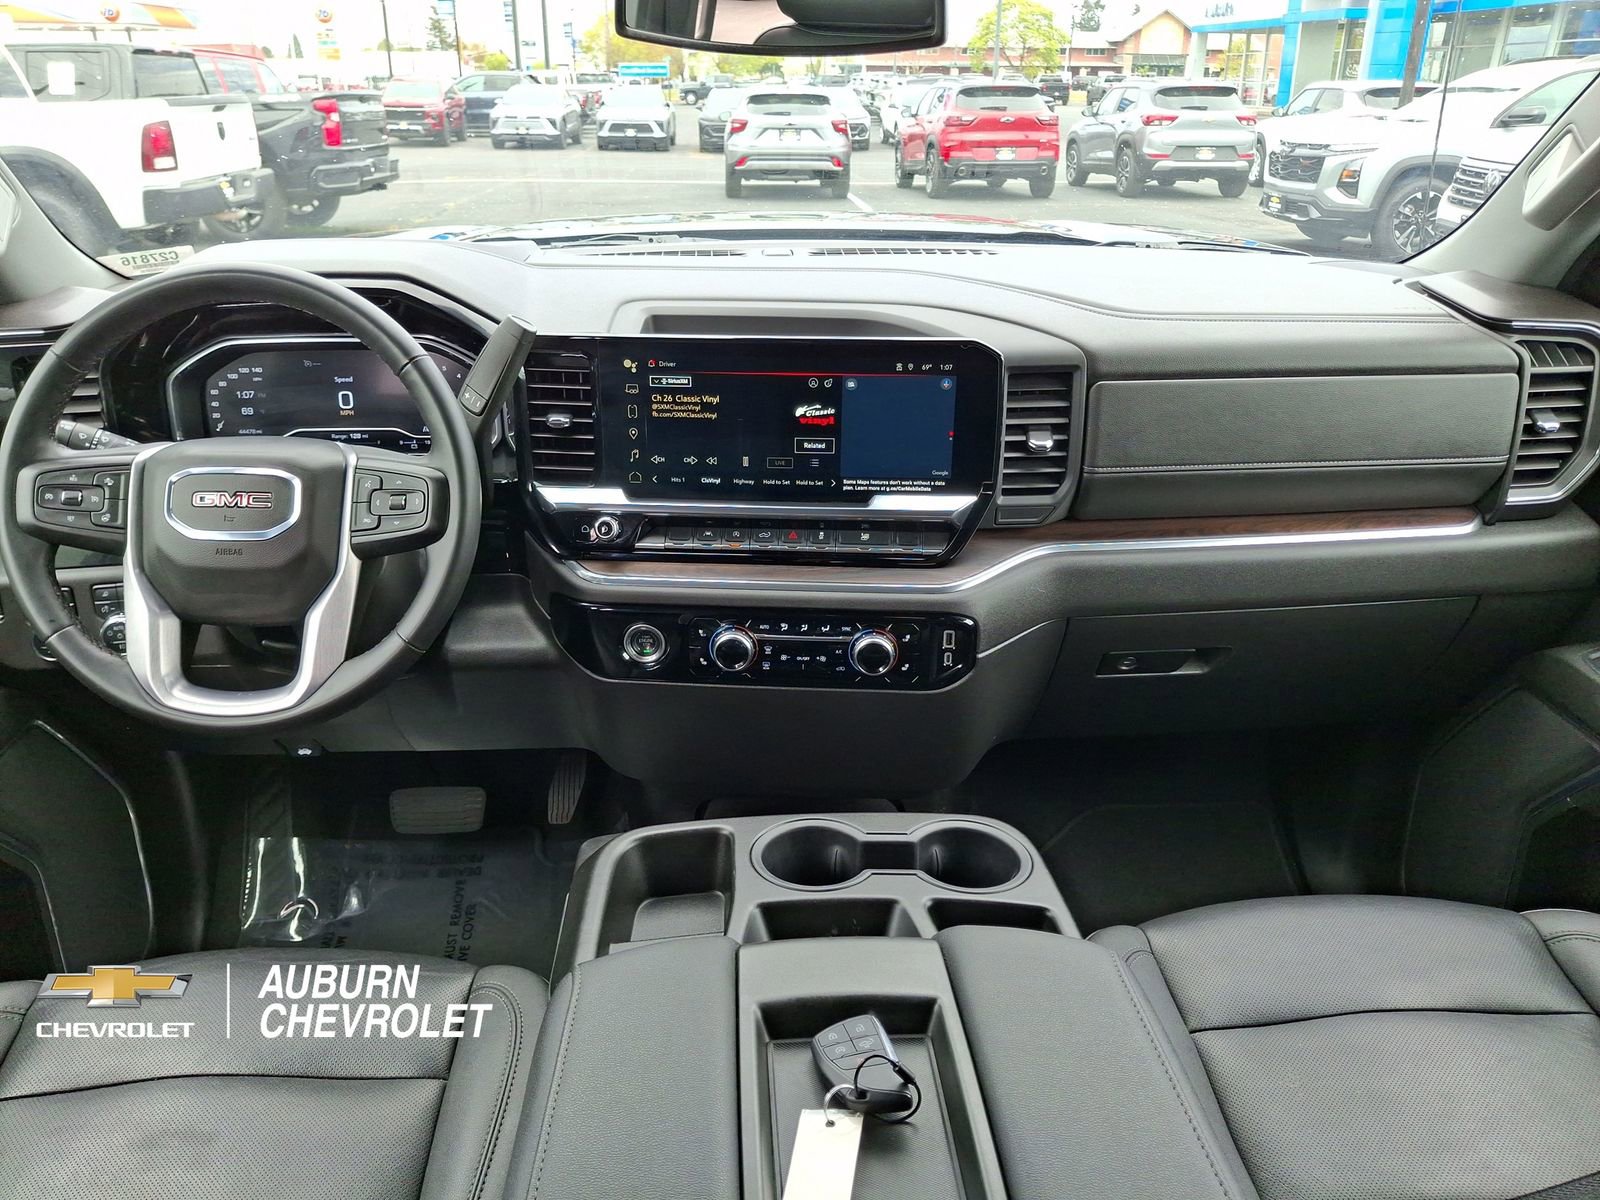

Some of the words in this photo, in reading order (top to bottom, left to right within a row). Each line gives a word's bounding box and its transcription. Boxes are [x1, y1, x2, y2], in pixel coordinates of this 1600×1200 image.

[658, 360, 676, 368] Driver
[334, 376, 353, 384] Speed
[236, 390, 255, 399] 1:07
[338, 390, 354, 410] 0
[651, 394, 663, 402] Ch
[663, 394, 673, 402] 26
[675, 394, 702, 403] Classic
[702, 395, 720, 405] Vinyl
[241, 407, 254, 416] 69
[651, 403, 701, 412] @SXMClassicVinyl
[651, 411, 718, 420] fb.com/SXMClassicVinyl
[932, 469, 949, 477] Google
[733, 478, 755, 486] Highway
[191, 491, 273, 509] GMC
[215, 547, 243, 556] AIRBAG
[450, 879, 467, 927] REMOVE
[461, 903, 478, 941] COVER
